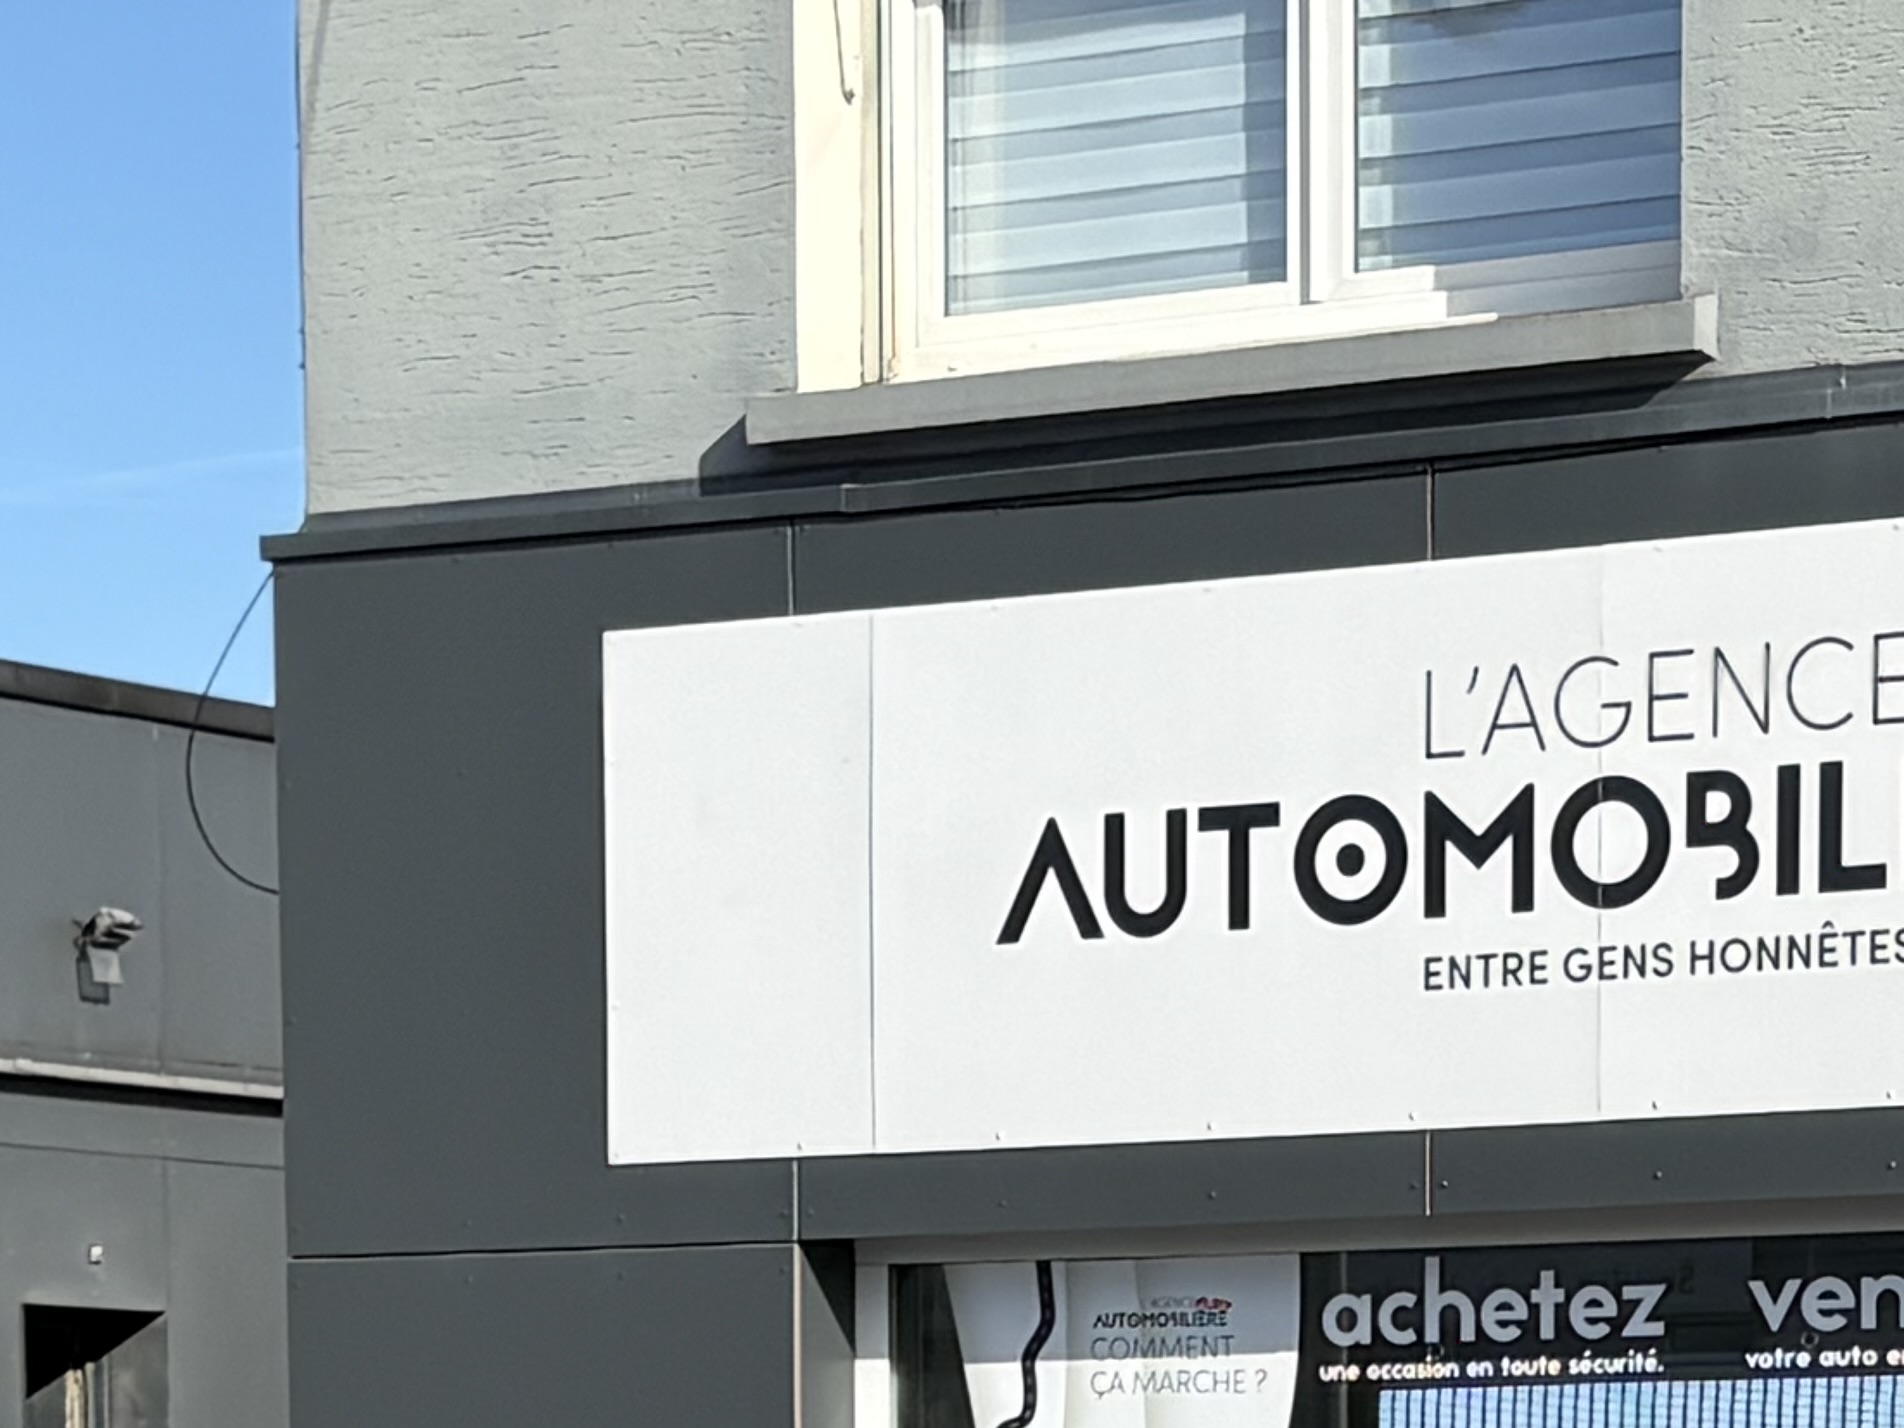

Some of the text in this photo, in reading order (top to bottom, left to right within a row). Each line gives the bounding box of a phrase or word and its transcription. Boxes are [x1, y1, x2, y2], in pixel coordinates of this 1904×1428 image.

[1423, 948, 1549, 992] ENTRE
[1563, 942, 1674, 984] GENS
[1322, 1256, 1667, 1347] achetez
[1091, 1335, 1235, 1361] COMMENT
[1319, 1347, 1665, 1382] une occasion en toute sécurité.
[1745, 1346, 1812, 1369] votre
[1818, 1346, 1879, 1368] auto
[1090, 1370, 1126, 1400] ÇA
[1132, 1369, 1246, 1395] MARCHE
